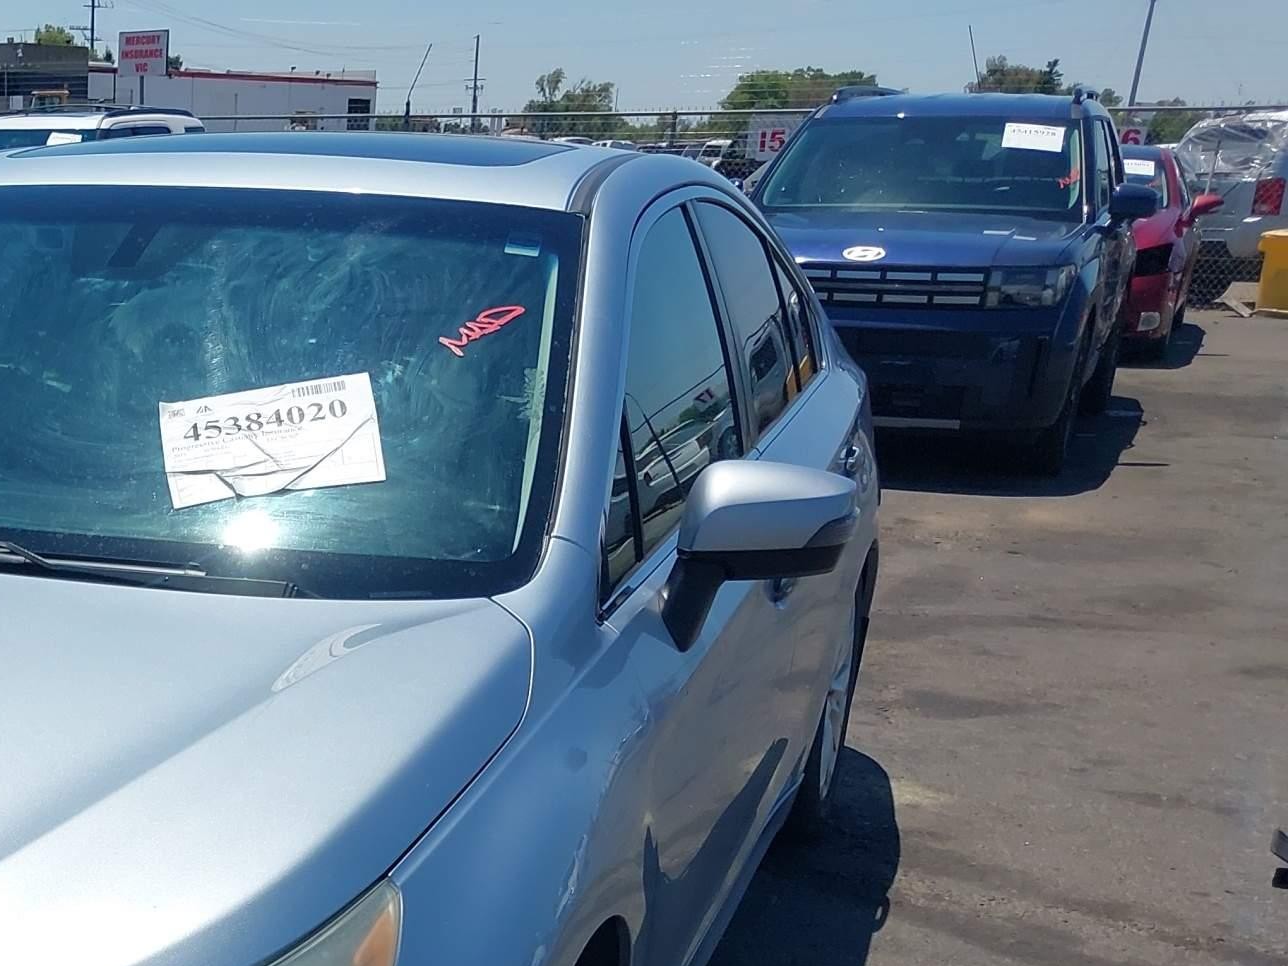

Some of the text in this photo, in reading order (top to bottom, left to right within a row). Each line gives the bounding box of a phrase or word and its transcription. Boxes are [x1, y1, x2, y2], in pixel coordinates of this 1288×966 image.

[125, 35, 160, 46] MERCURY
[121, 48, 163, 59] INSURANCE
[759, 128, 786, 152] 15
[184, 399, 348, 441] 45384020
